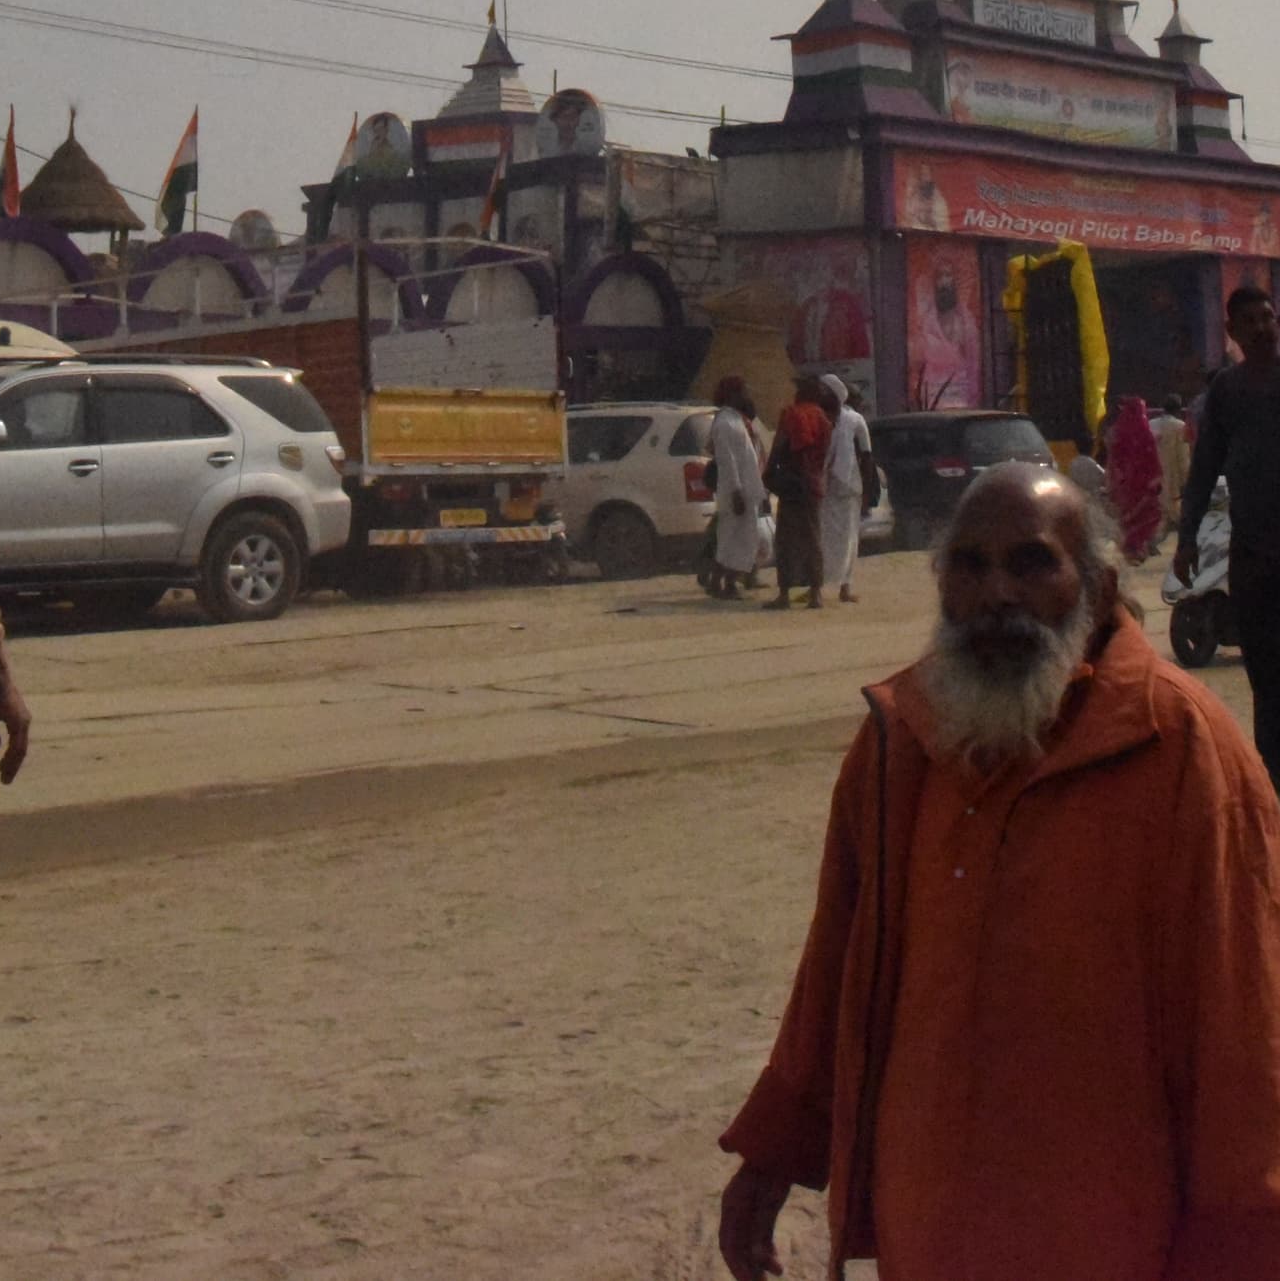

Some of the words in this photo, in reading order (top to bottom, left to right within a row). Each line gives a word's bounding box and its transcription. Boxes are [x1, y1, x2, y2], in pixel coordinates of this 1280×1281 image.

[962, 207, 1077, 239] Mahayogi
[1080, 221, 1129, 241] Pilot
[1134, 226, 1185, 245] Baba
[1189, 230, 1243, 252] Camp
